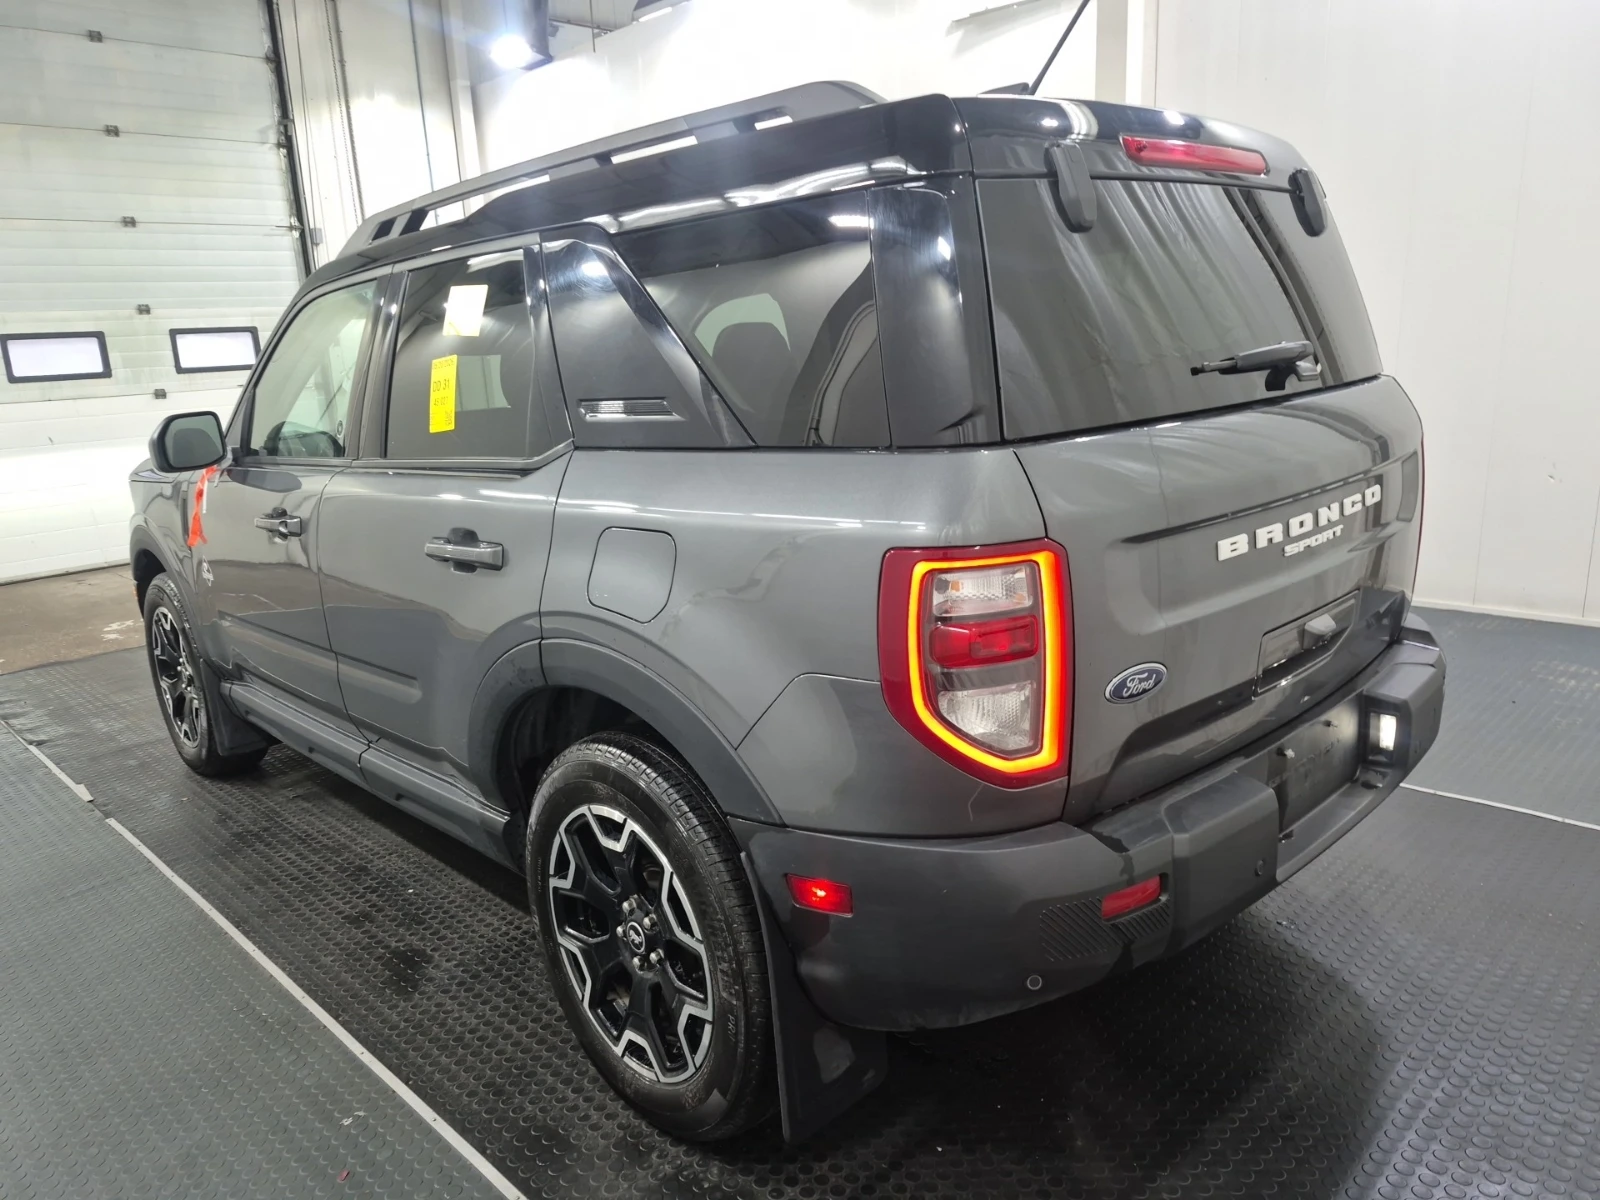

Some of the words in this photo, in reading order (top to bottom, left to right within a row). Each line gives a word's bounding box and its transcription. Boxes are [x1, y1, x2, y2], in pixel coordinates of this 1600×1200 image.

[1217, 484, 1382, 561] BRONCO
[1283, 524, 1344, 557] SPORT
[1122, 672, 1157, 698] Ford
